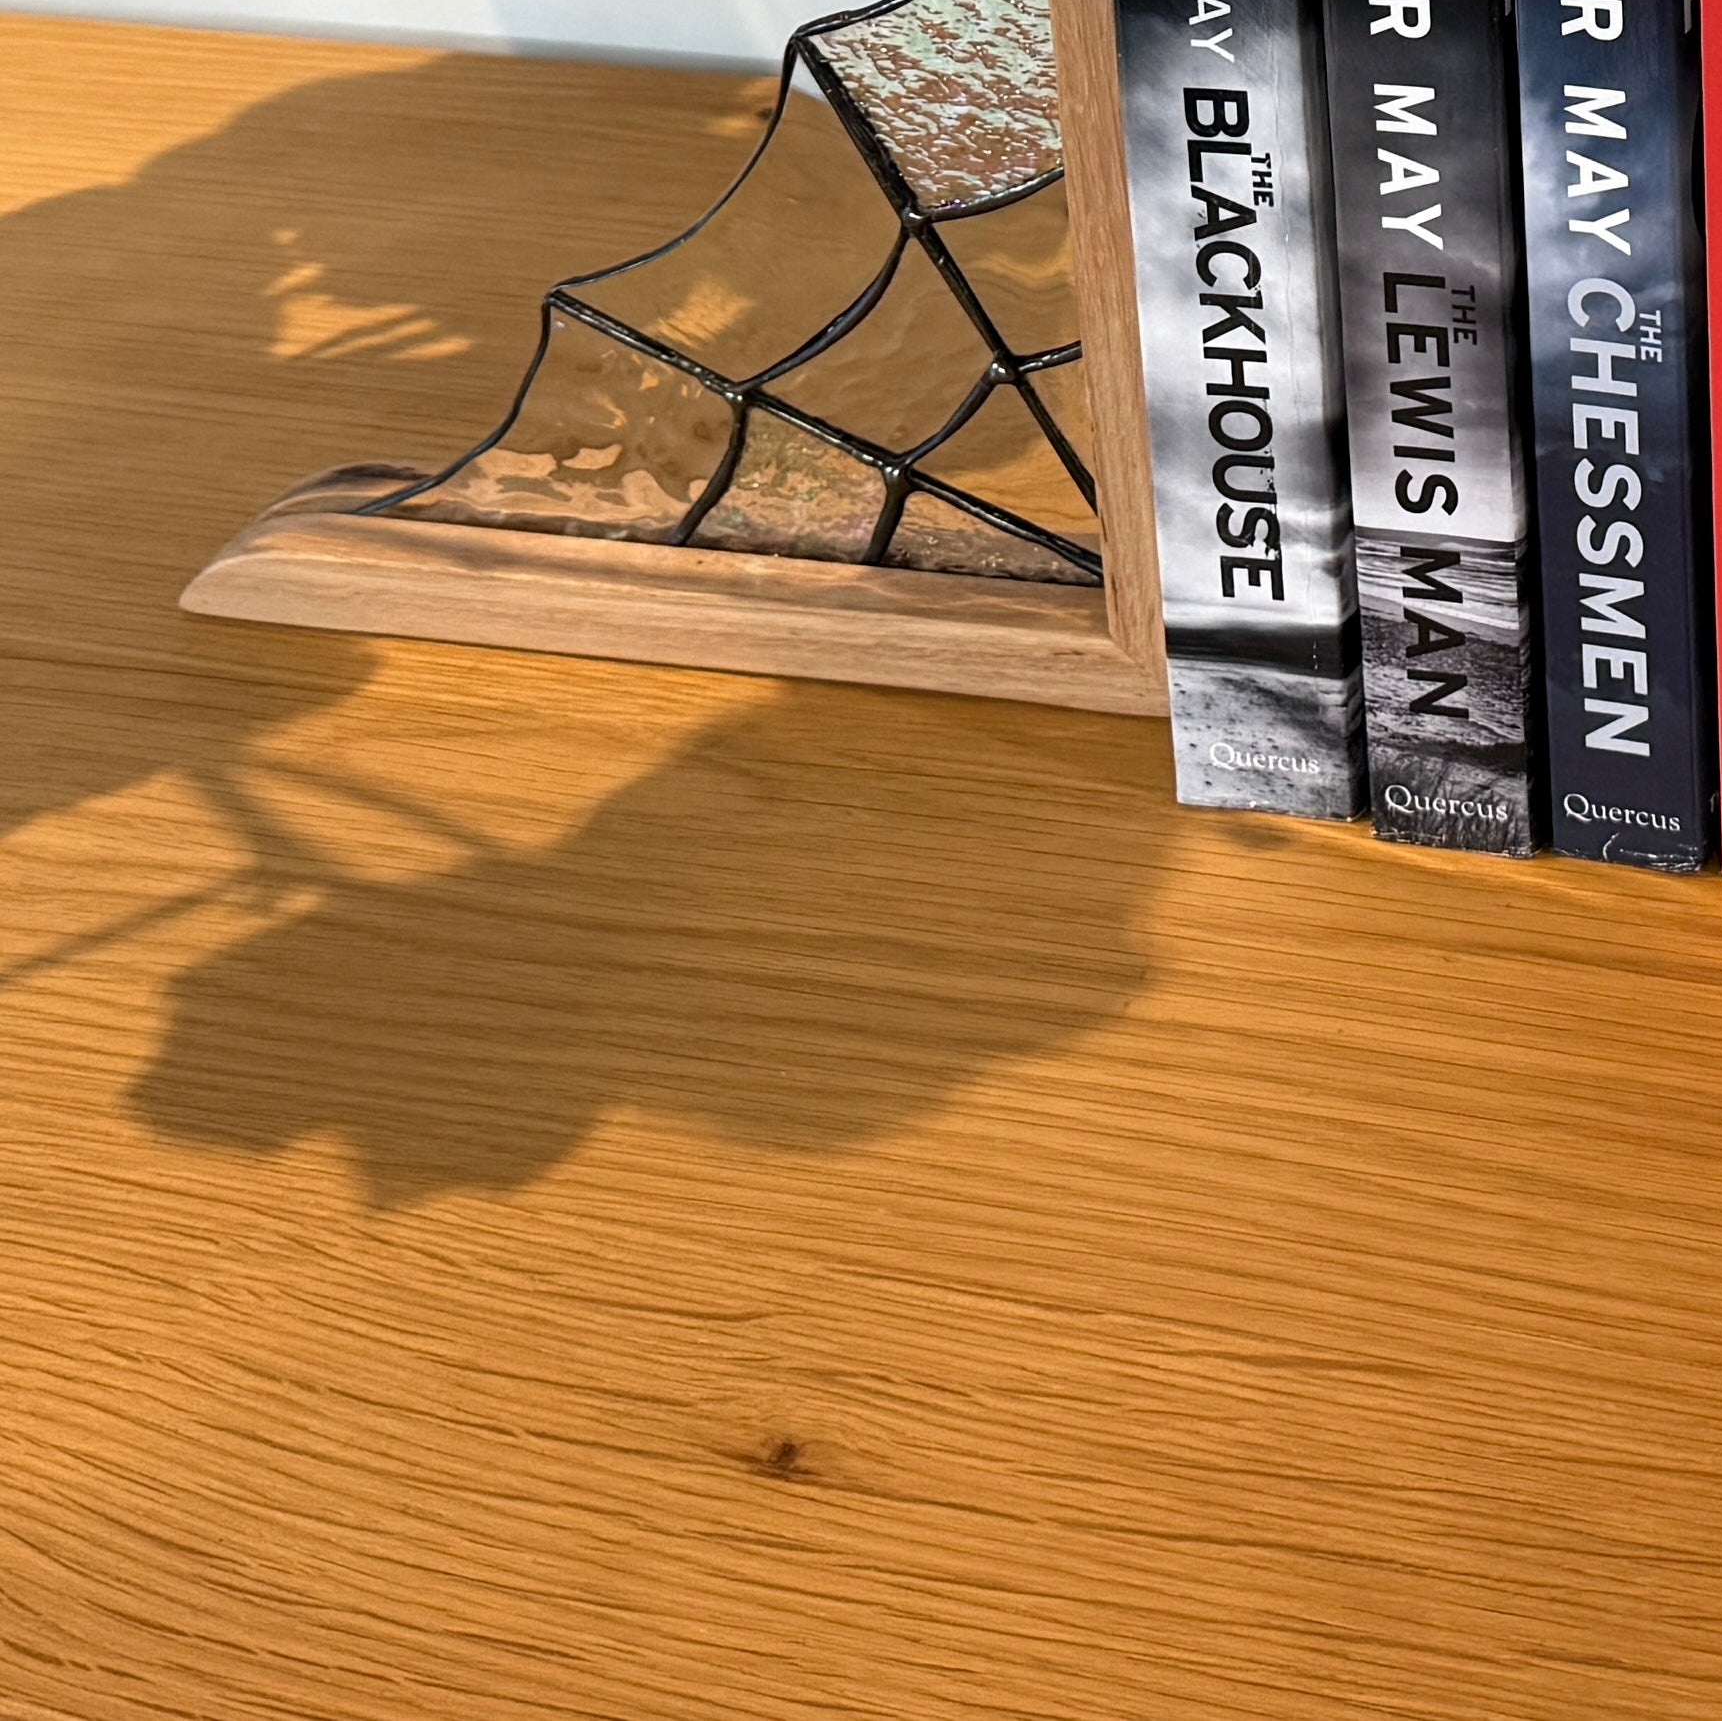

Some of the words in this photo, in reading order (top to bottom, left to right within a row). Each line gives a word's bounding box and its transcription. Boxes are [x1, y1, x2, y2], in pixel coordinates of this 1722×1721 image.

[1250, 152, 1275, 208] THE
[1373, 83, 1444, 251] MAY
[1563, 84, 1632, 256] MAY
[1183, 87, 1285, 601] BLACKHOUSE
[1450, 284, 1478, 346] THE
[1639, 309, 1663, 364] THE
[1382, 271, 1460, 517] LEWIS
[1567, 277, 1651, 758] CHESSMEN
[1399, 546, 1470, 720] MAN
[1209, 742, 1321, 774] Quercus
[1384, 784, 1508, 822] Quercus
[1563, 793, 1682, 832] Quercus
